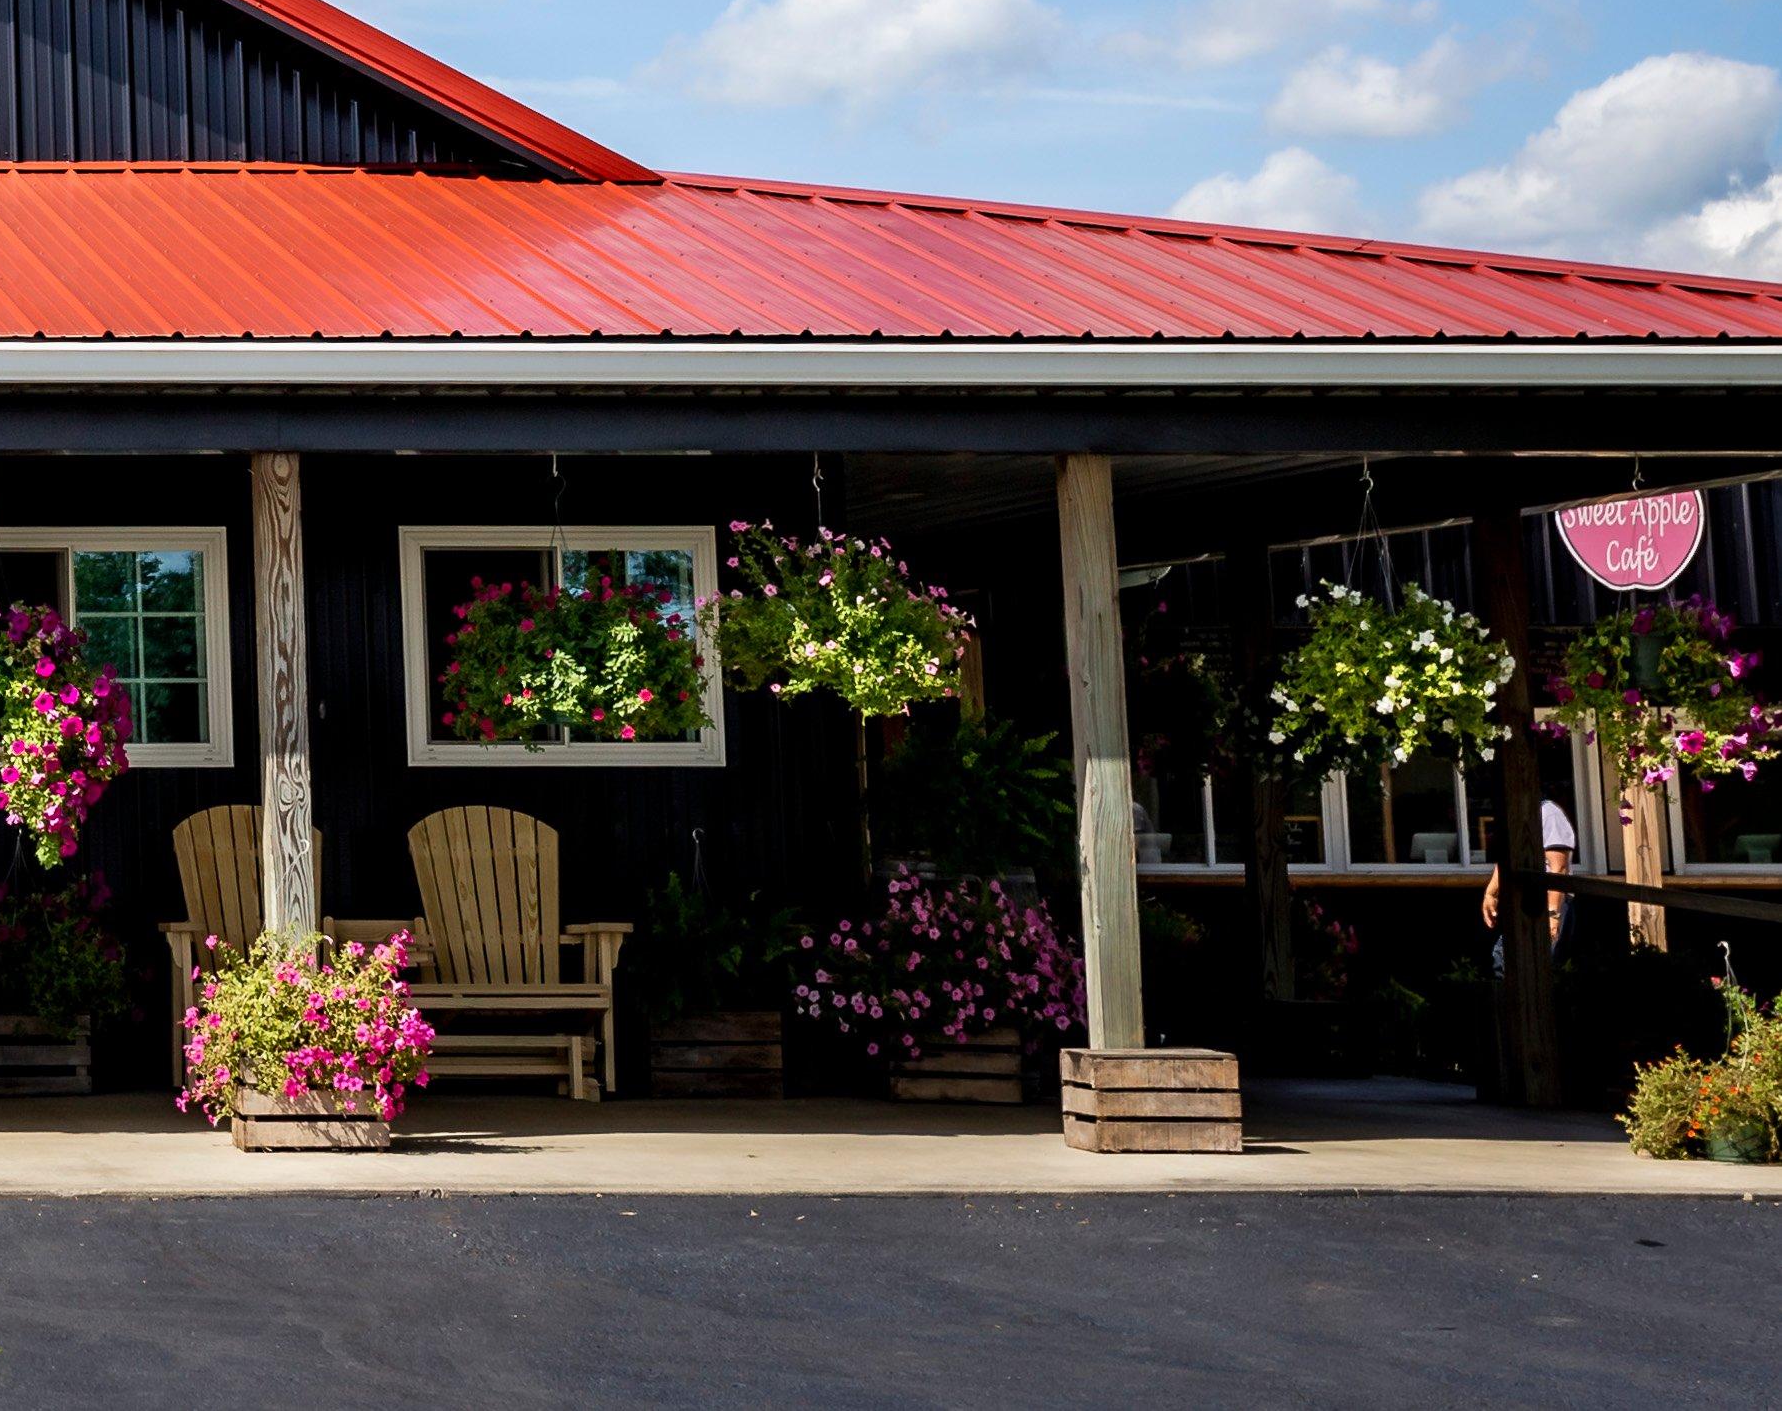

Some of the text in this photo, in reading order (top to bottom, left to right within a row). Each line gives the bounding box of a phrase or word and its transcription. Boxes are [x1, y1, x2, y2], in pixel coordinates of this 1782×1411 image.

[1563, 492, 1696, 537] Sweet Apple
[1606, 535, 1659, 579] Café
